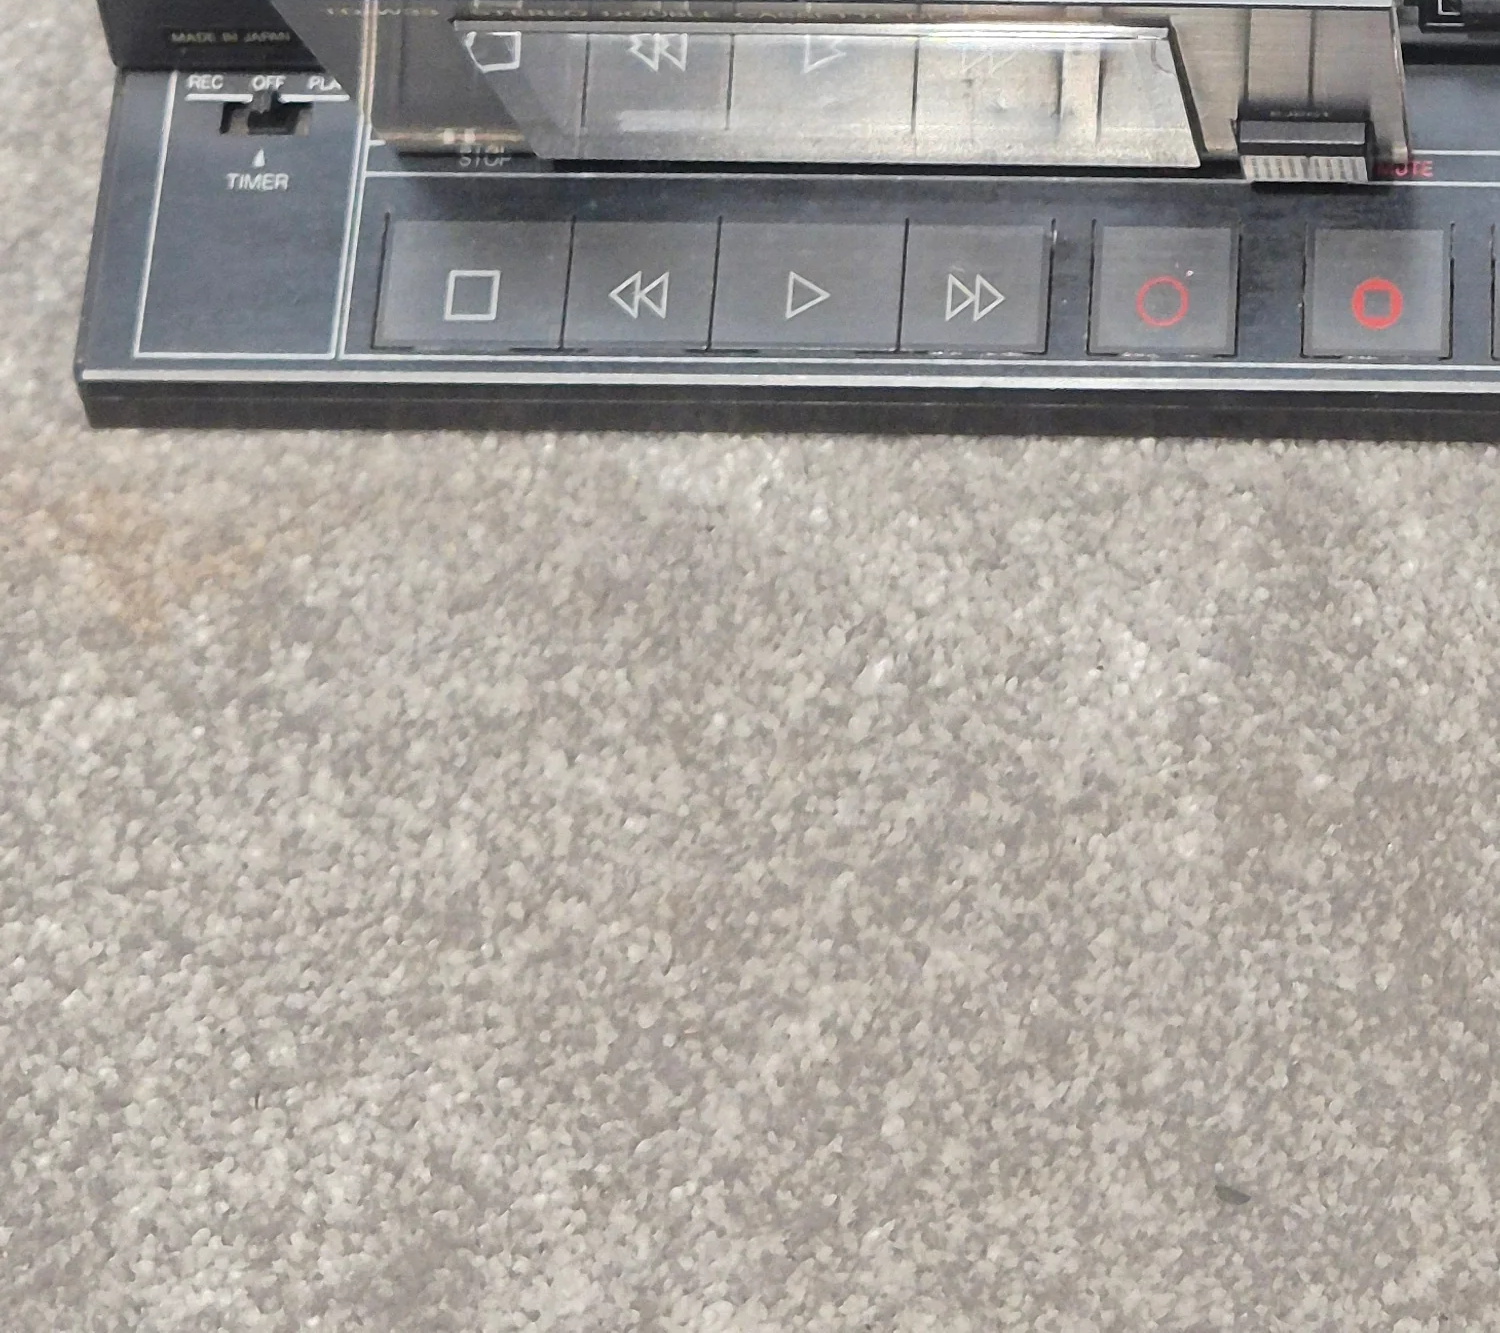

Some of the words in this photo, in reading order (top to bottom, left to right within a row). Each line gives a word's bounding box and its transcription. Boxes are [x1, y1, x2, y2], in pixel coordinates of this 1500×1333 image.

[170, 32, 216, 42] MADE
[222, 32, 238, 42] IN
[244, 32, 291, 42] JAPAN
[186, 73, 224, 91] REC
[251, 74, 287, 91] OFF
[307, 75, 342, 91] PLA
[226, 172, 290, 191] TIMER
